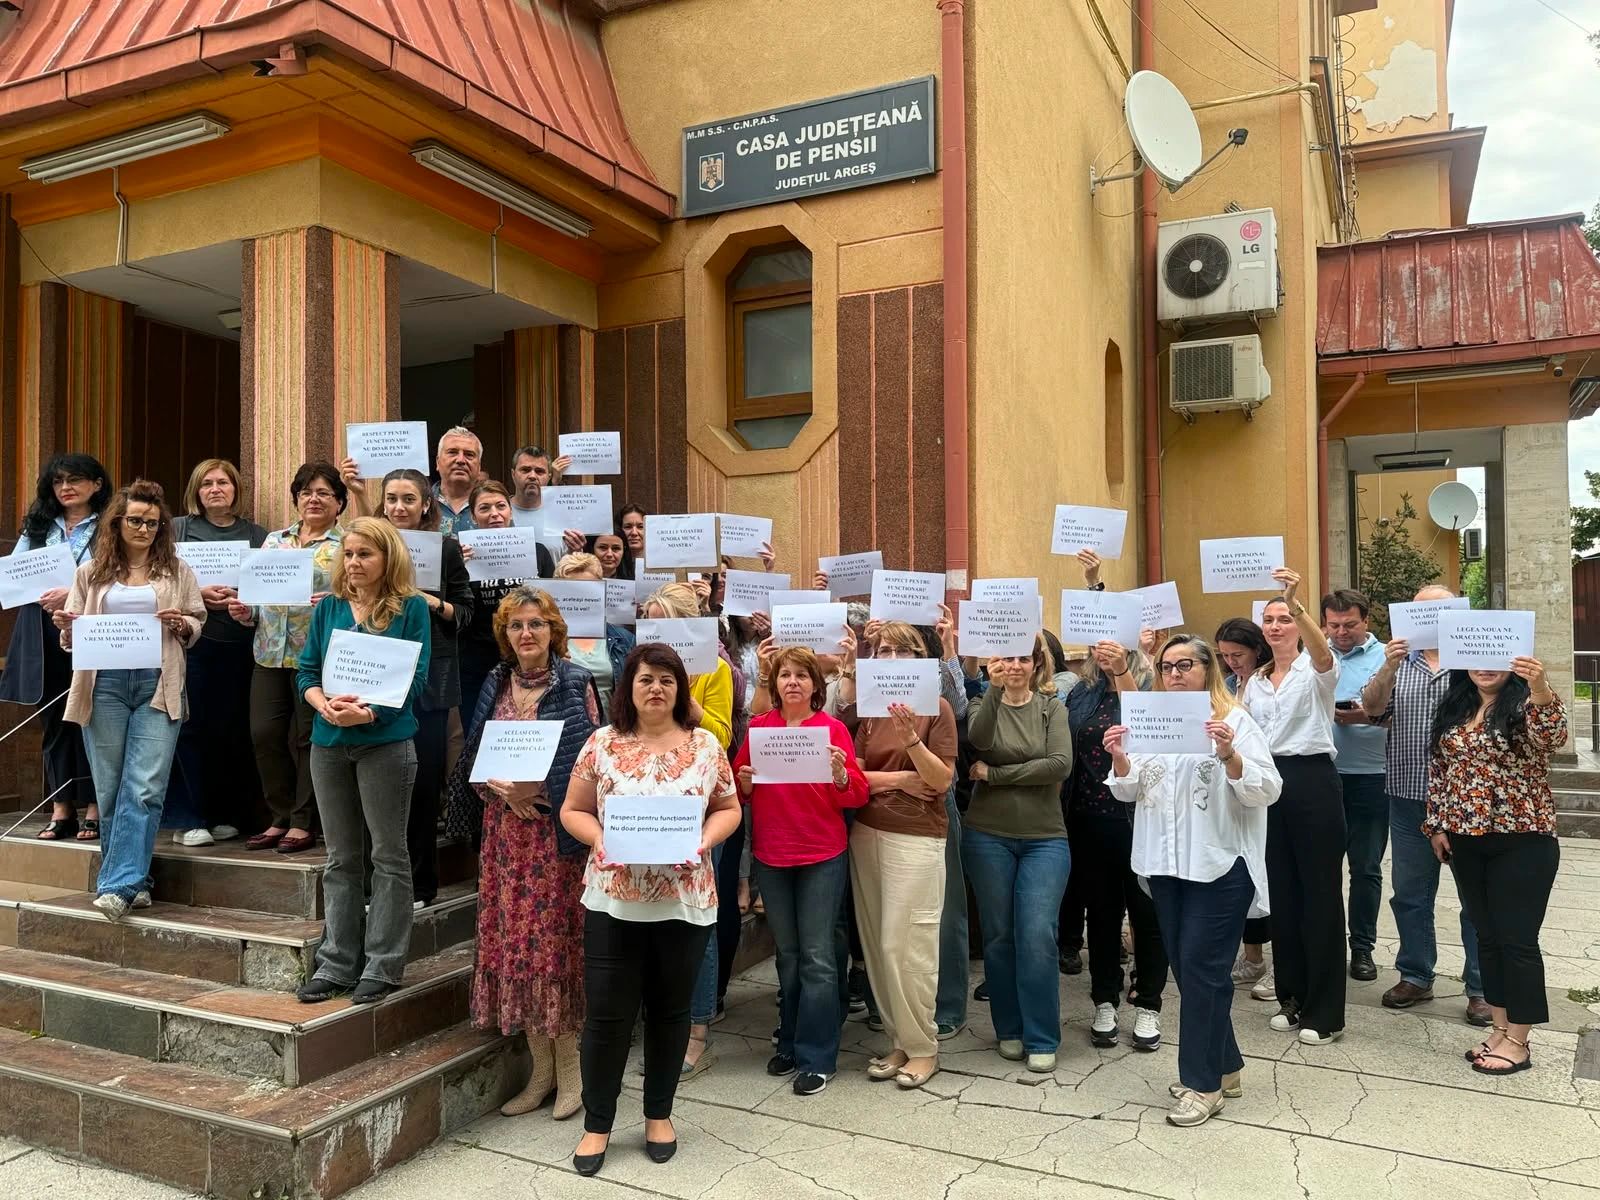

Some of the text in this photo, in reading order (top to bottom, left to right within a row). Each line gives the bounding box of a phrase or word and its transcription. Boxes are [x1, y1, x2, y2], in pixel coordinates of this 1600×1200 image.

[733, 114, 779, 131] C.N.P.A.S.
[736, 99, 922, 157] CASA JUDEȚEANĂ
[775, 135, 877, 171] DE PENSII
[775, 171, 831, 191] JUDEȚUL
[1242, 243, 1260, 254] LG
[610, 814, 636, 822] Respect
